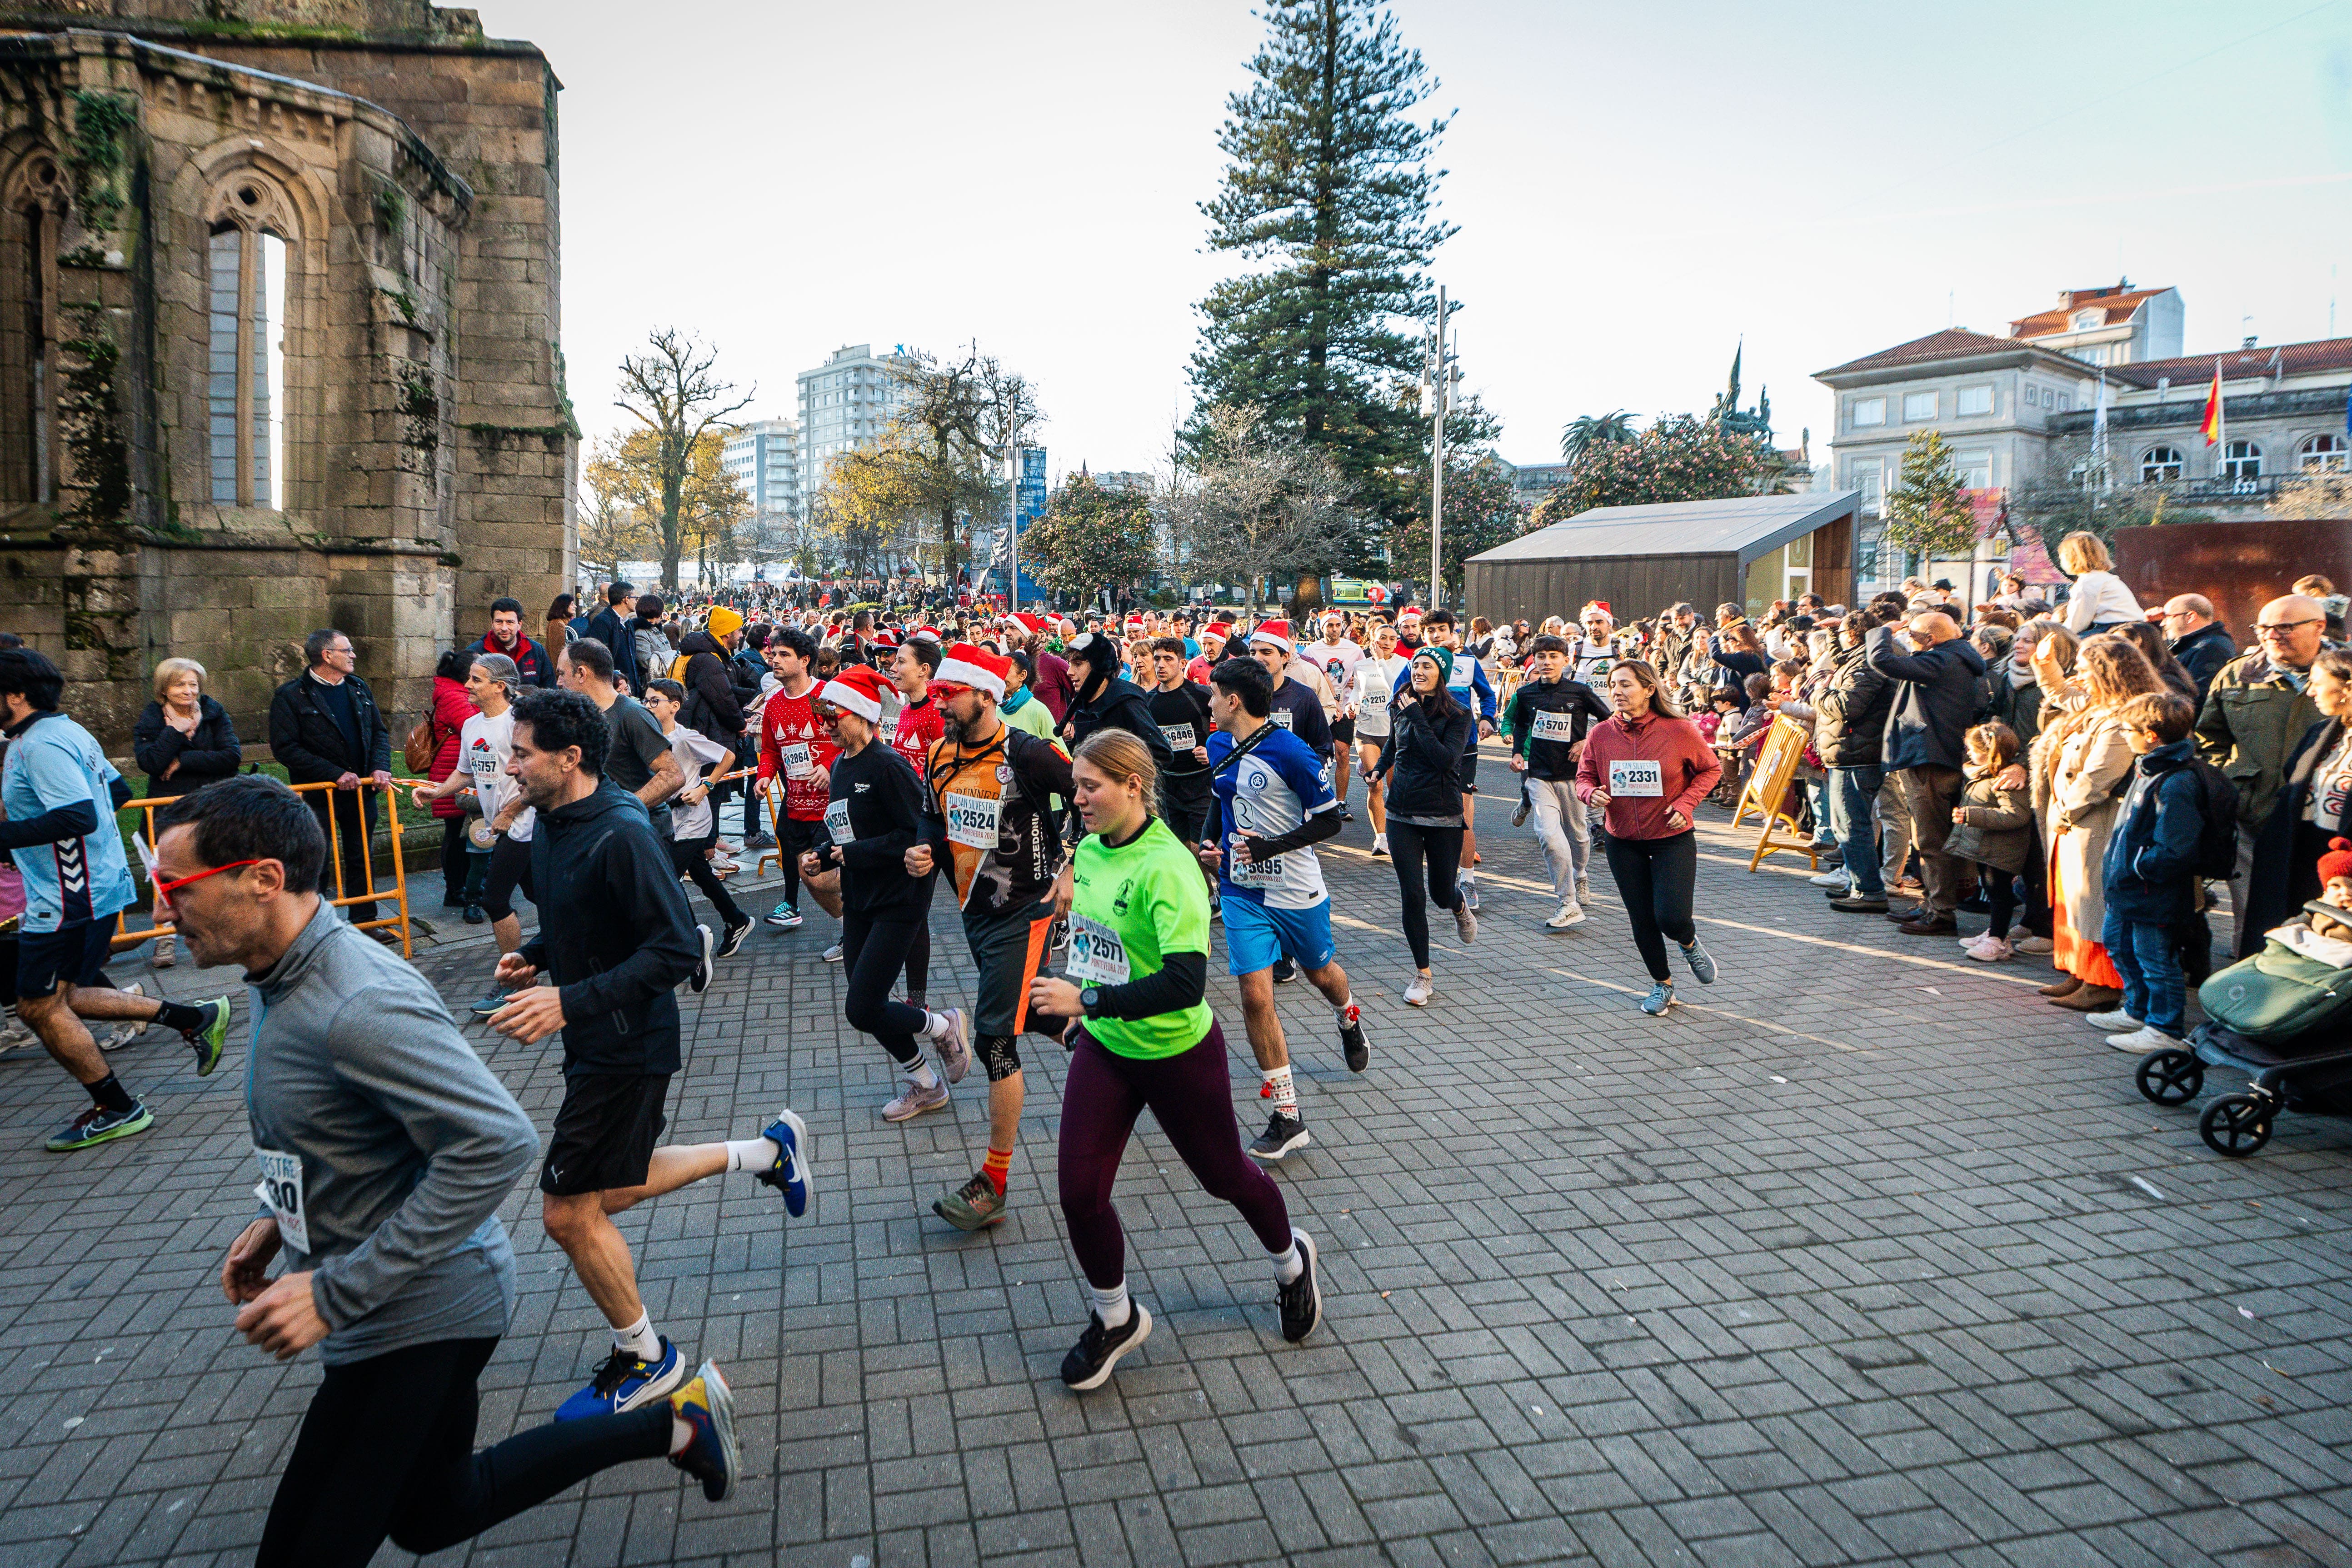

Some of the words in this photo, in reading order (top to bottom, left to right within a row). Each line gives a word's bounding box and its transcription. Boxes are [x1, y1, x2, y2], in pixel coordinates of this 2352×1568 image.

[1423, 649, 1446, 669] X-MAS
[1546, 720, 1568, 731] 5707
[1171, 730, 1193, 741] 6446
[791, 751, 809, 764] 2864
[478, 760, 496, 772] 5757
[1629, 770, 1657, 782] 2331
[958, 798, 968, 808] SAN
[969, 800, 995, 813] SILVESTRE
[963, 809, 995, 830] 2524
[963, 827, 983, 839] PONTEVEDRA
[1031, 812, 1041, 880] CALZEDONIA
[1248, 859, 1282, 874] 5895
[1093, 934, 1123, 963] 2577
[1091, 958, 1116, 974] PONTEVEDRA
